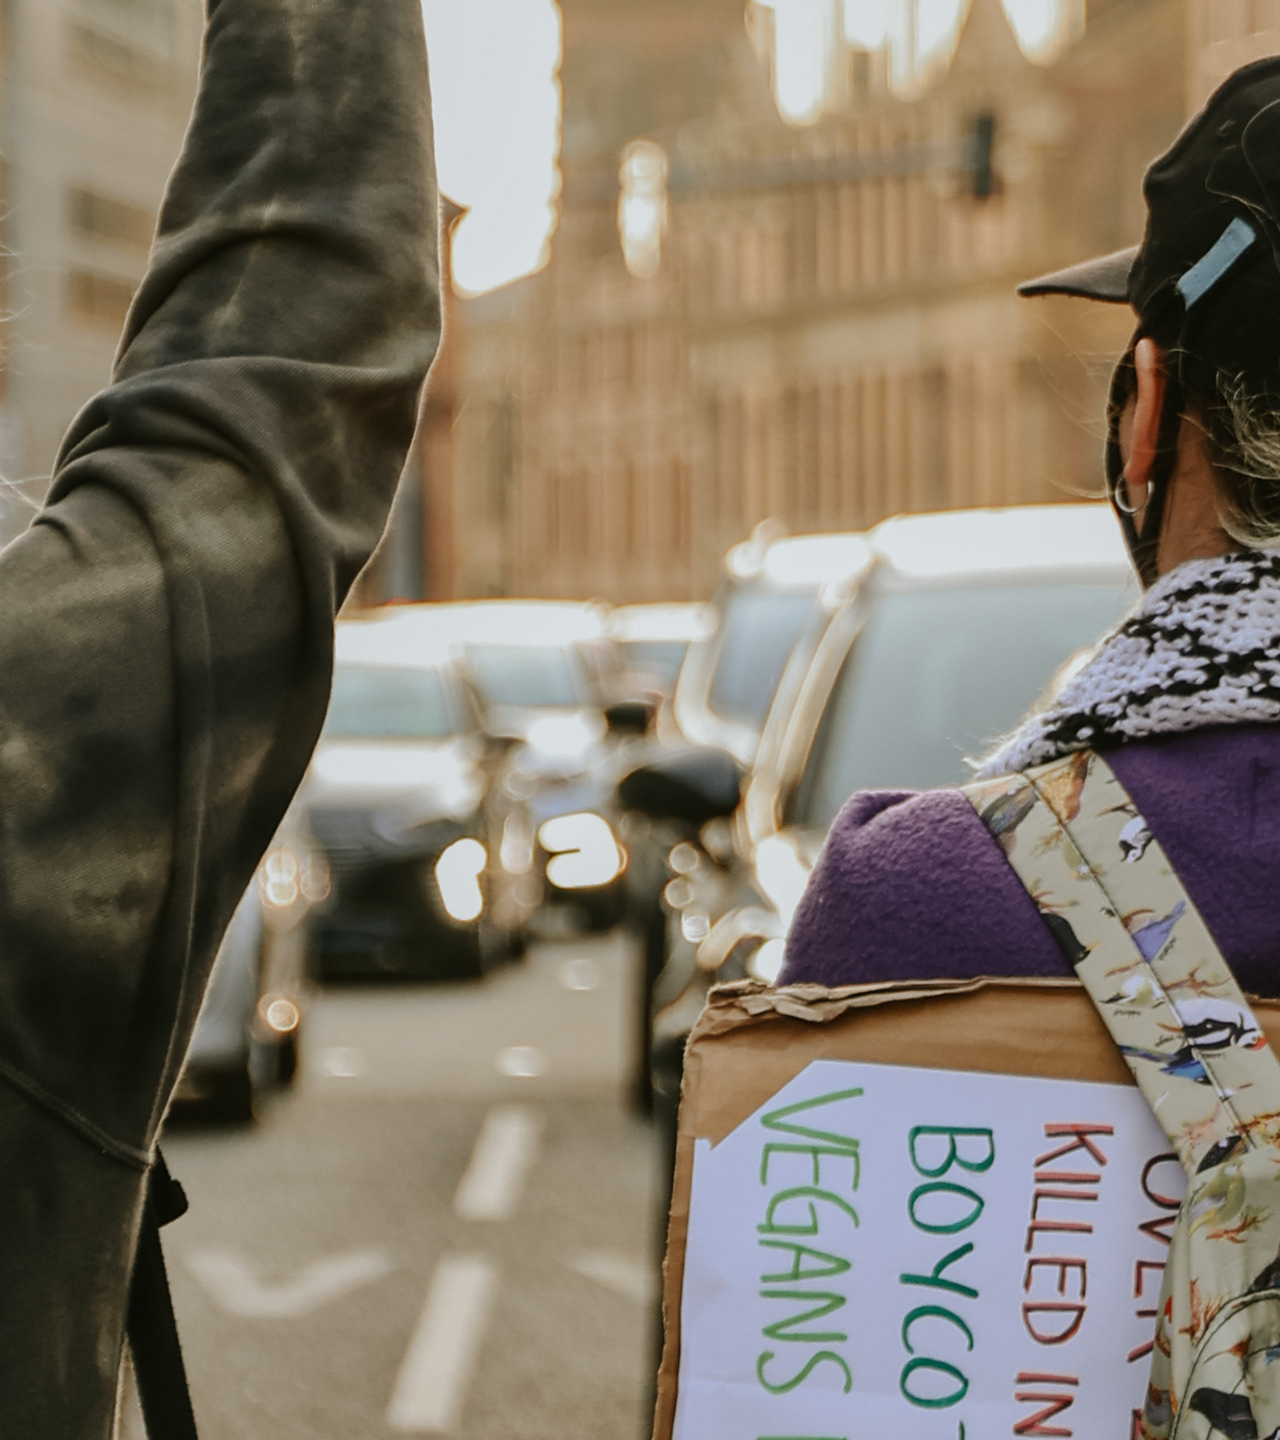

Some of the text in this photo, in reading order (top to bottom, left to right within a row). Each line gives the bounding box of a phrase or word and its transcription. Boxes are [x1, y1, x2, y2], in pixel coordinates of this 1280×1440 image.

[756, 1087, 863, 1396] VEGANS
[1021, 1123, 1115, 1345] KILLED
[1013, 1371, 1080, 1437] IN
